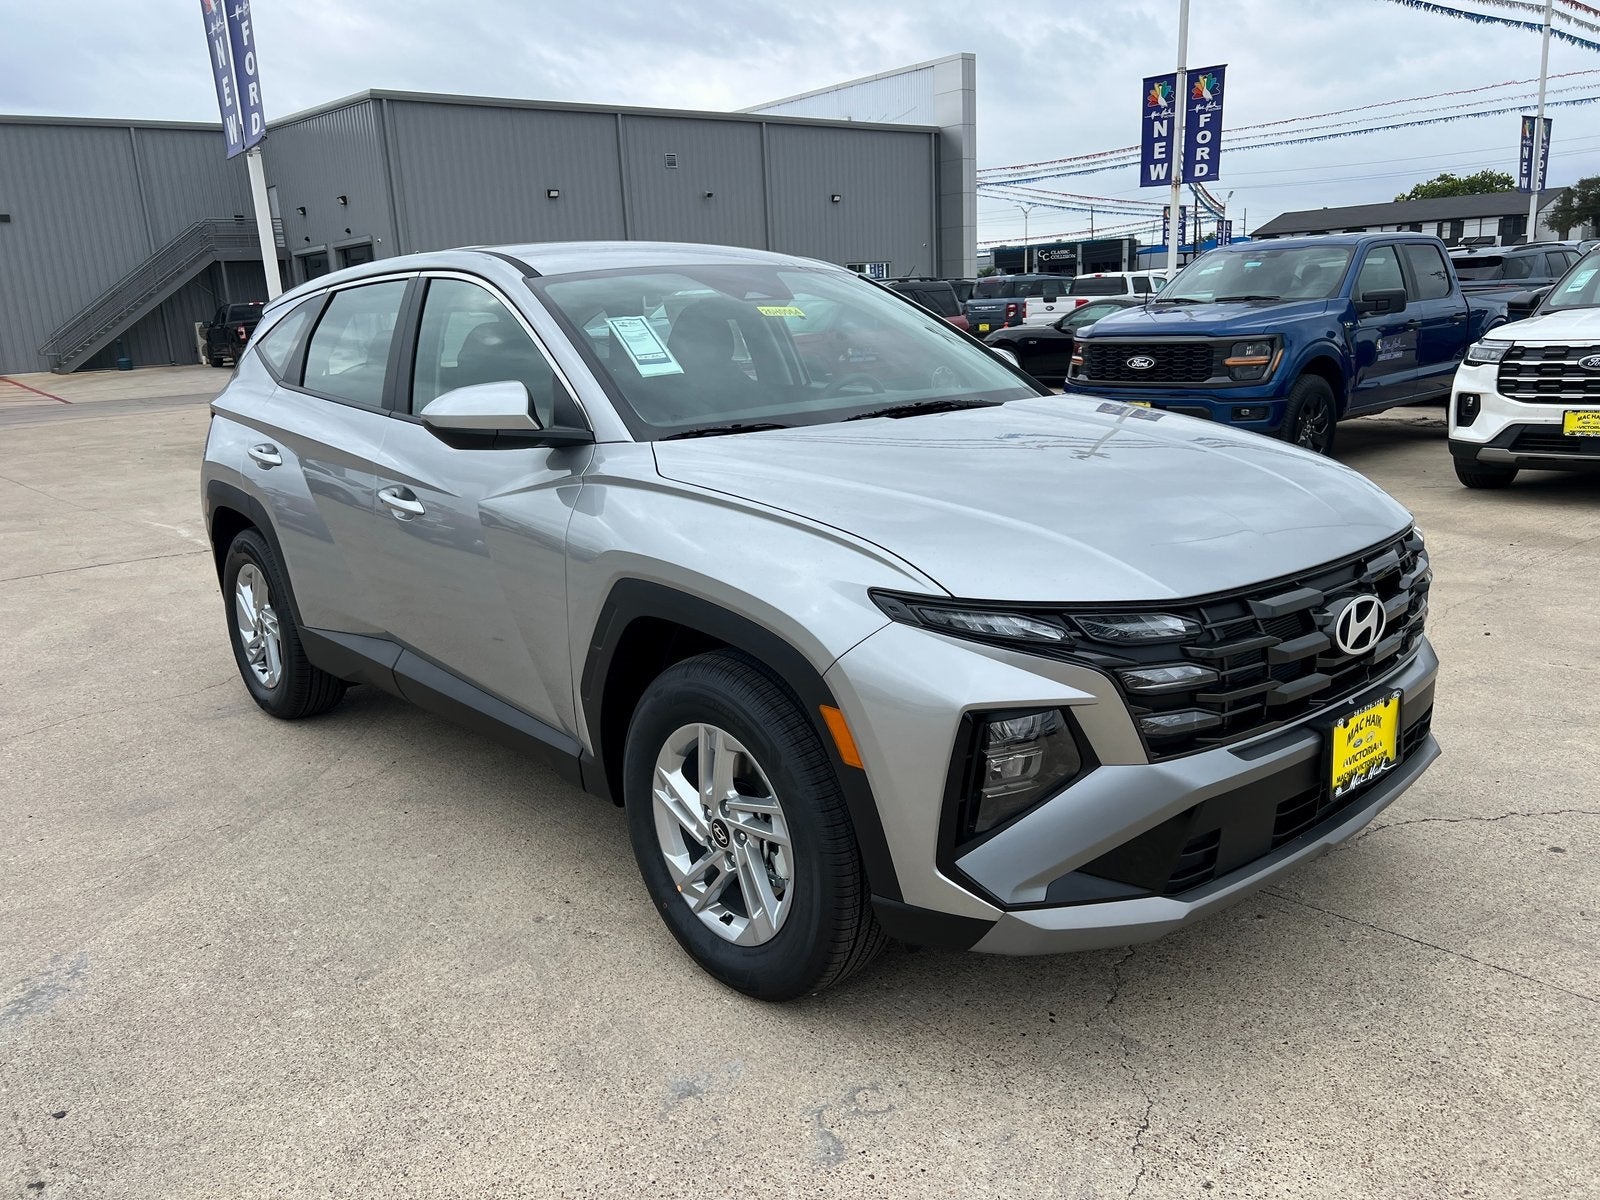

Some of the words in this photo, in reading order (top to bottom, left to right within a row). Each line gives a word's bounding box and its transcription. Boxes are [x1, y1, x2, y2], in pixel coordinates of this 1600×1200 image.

[215, 36, 238, 145] NEW
[241, 20, 260, 136] FORD
[1149, 120, 1168, 180] NEW
[1194, 113, 1212, 177] FORD
[1521, 147, 1529, 189] NEW
[1577, 414, 1590, 422] MAC
[1347, 718, 1364, 746] MAC
[1365, 714, 1383, 728] HAIK
[1348, 743, 1377, 765] VICTORIA
